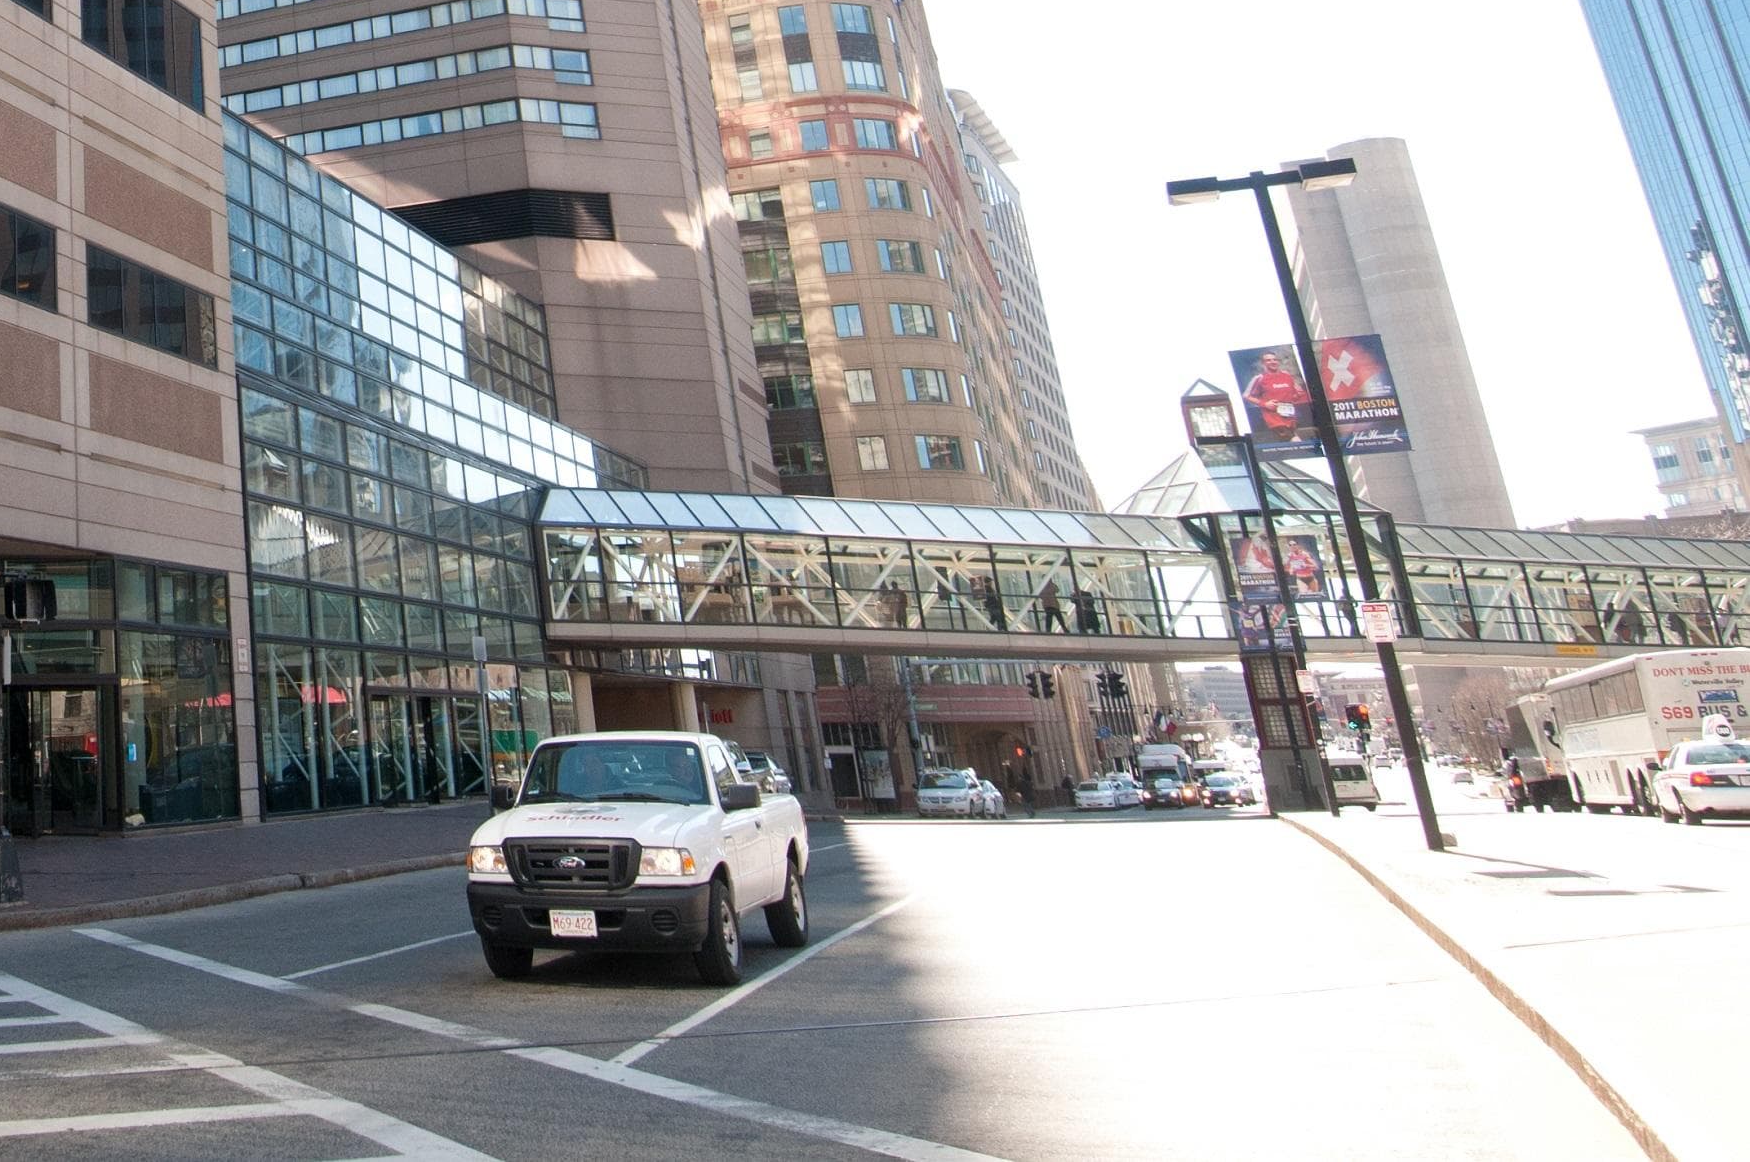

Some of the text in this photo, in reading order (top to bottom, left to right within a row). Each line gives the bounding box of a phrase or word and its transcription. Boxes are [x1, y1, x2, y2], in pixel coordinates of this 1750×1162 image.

[1333, 398, 1396, 412] 2011 BOSTON
[1335, 408, 1399, 420] MARATHON
[1652, 667, 1685, 678] DON'T
[1686, 666, 1713, 676] MISS
[1716, 665, 1736, 675] THE
[1697, 704, 1731, 719] BUS
[1736, 704, 1748, 718] &
[574, 917, 593, 930] 422
